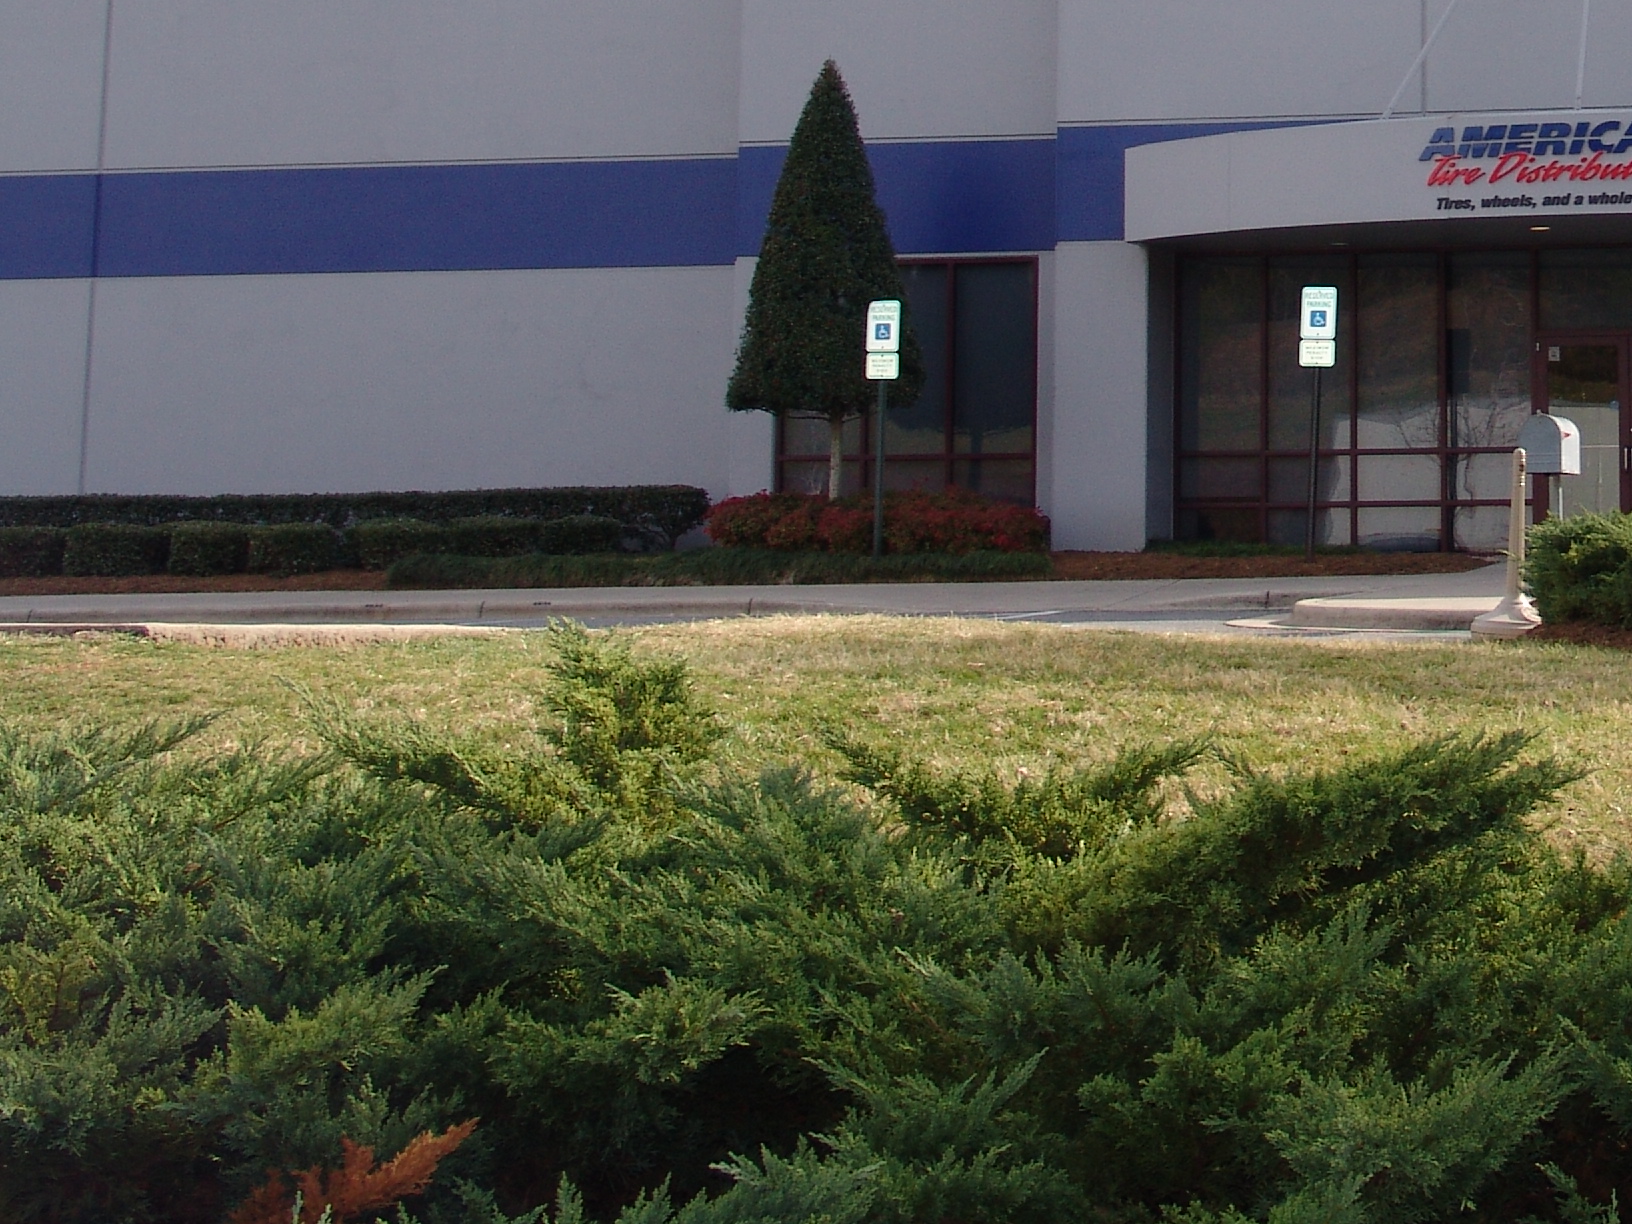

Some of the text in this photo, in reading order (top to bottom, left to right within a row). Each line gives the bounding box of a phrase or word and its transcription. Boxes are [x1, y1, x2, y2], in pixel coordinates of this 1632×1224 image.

[1427, 154, 1486, 188] Tire
[1436, 197, 1476, 211] Tires,
[1480, 194, 1537, 209] wheels,
[1542, 192, 1570, 207] and
[1573, 195, 1584, 206] a
[1588, 191, 1632, 205] whole
